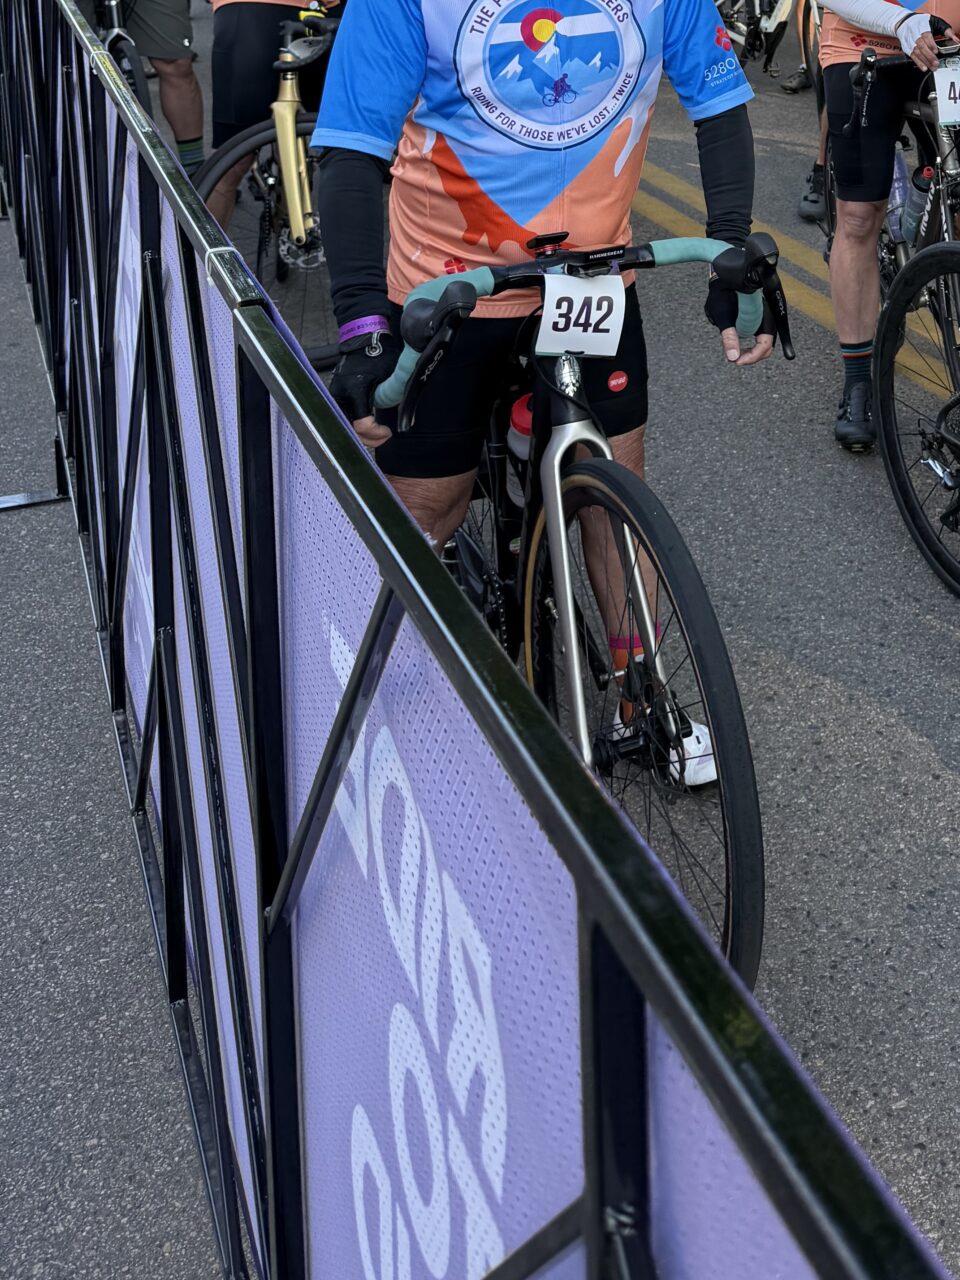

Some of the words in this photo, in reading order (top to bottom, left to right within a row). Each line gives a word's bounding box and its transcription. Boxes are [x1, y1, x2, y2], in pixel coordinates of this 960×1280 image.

[469, 6, 496, 36] THE
[704, 57, 736, 81] 5280
[471, 86, 498, 114] RIDING
[495, 111, 517, 131] FOR
[518, 124, 554, 142] THOSE
[556, 124, 588, 142] WE'VE
[552, 295, 614, 334] 342
